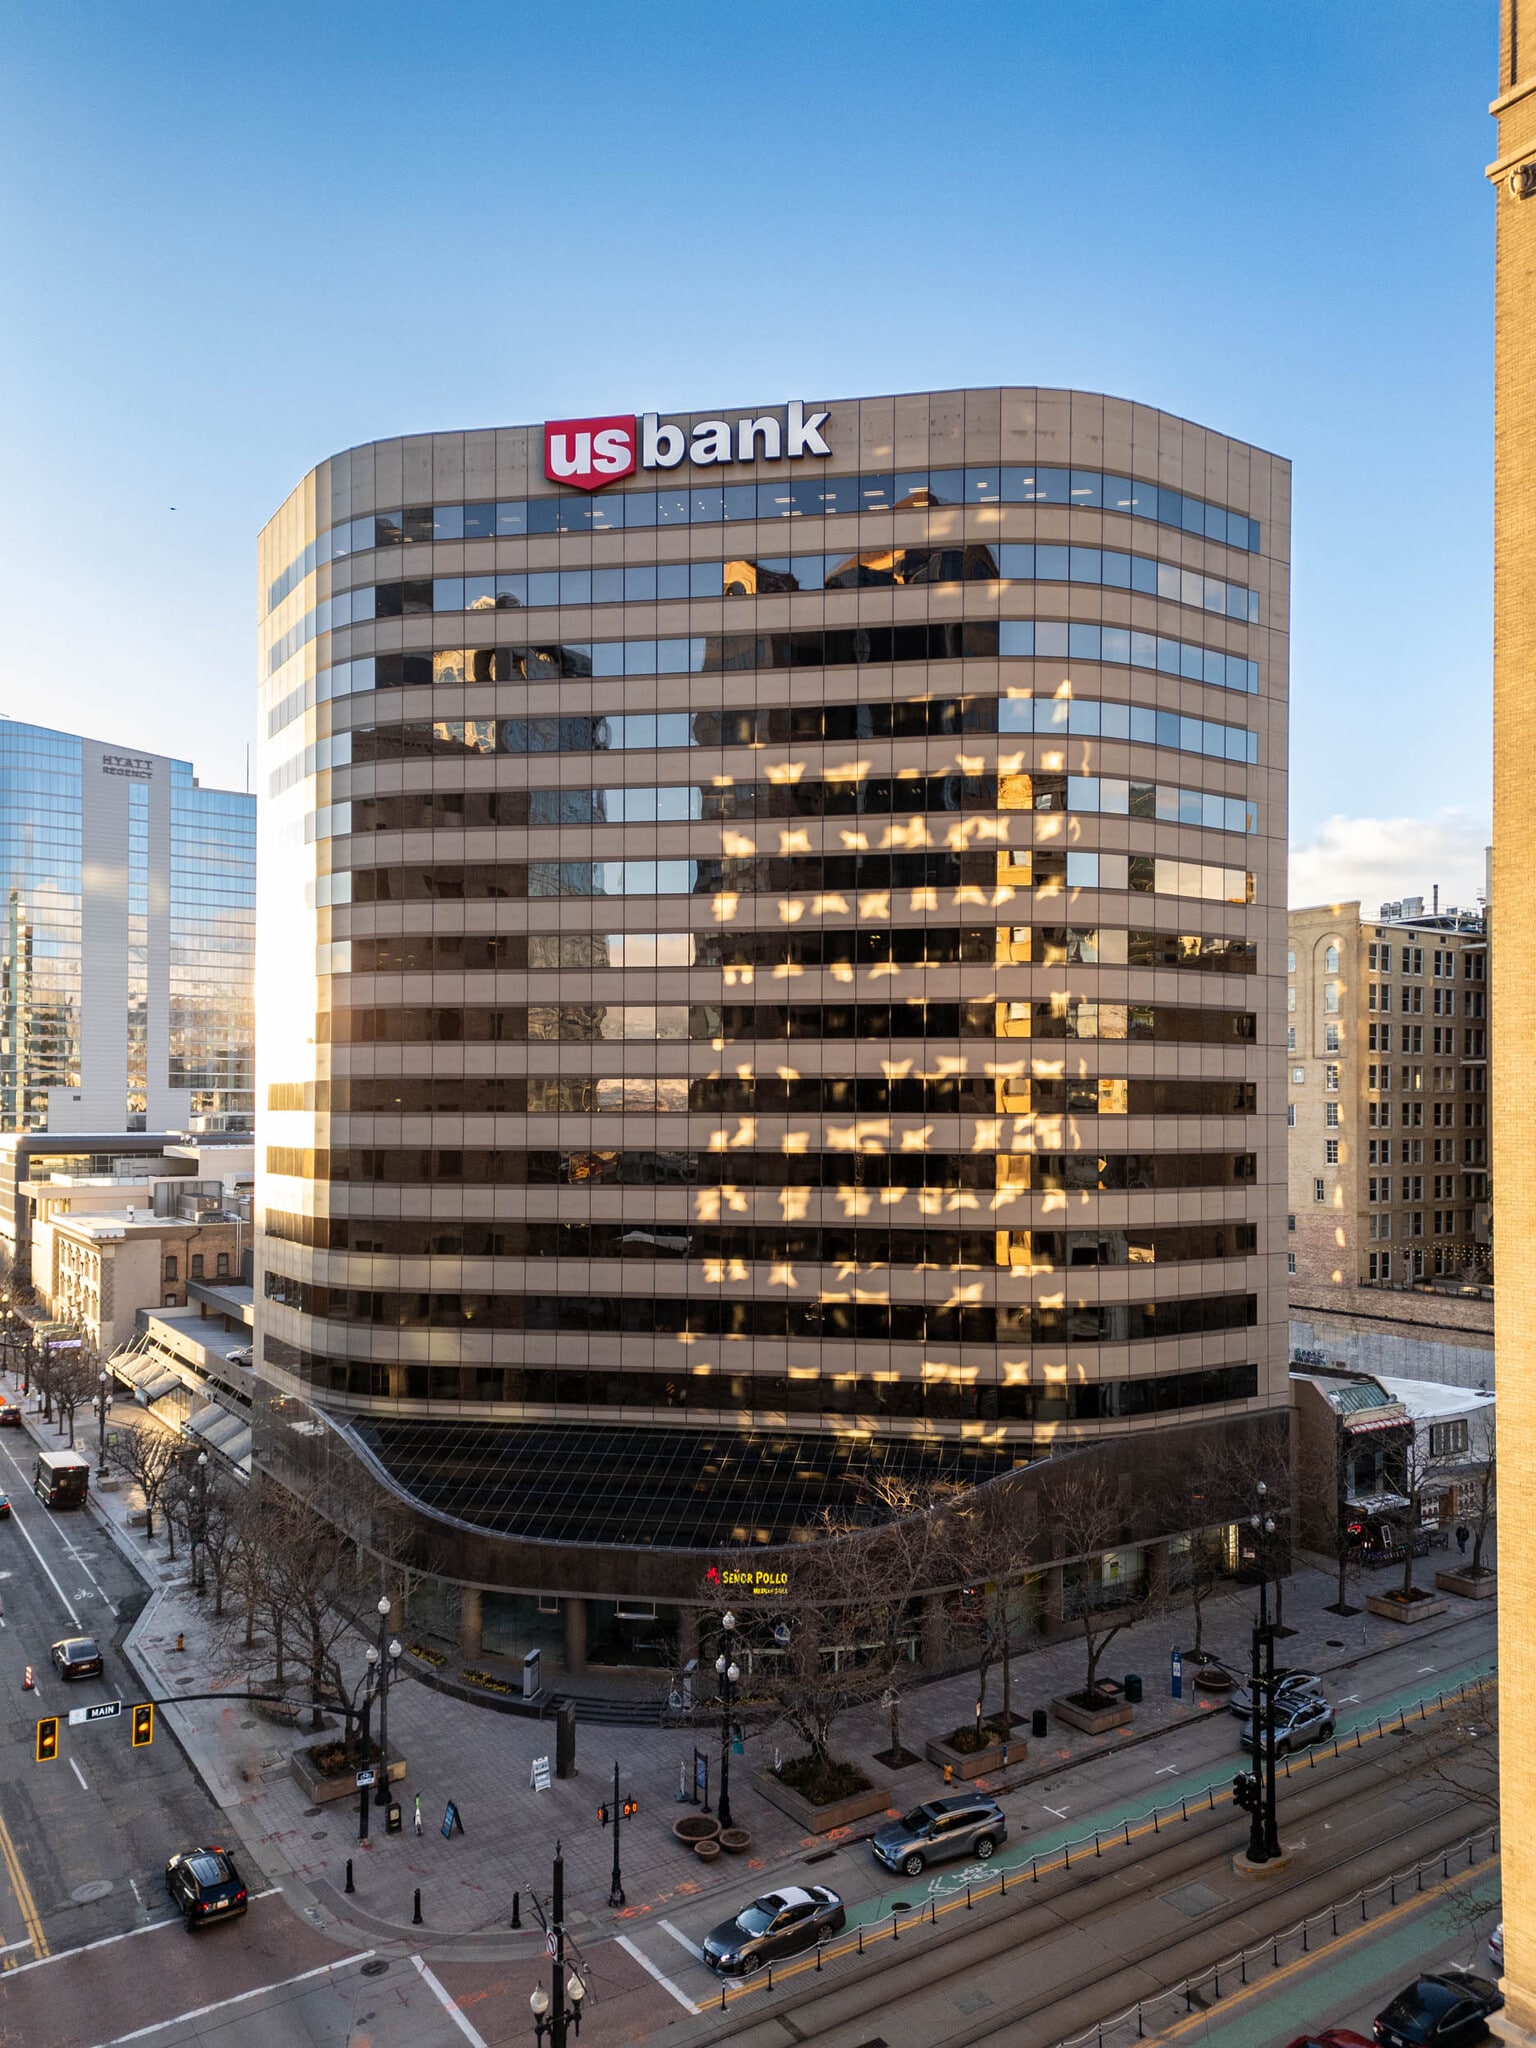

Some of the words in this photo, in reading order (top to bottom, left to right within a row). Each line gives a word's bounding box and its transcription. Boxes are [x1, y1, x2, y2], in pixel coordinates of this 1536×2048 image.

[550, 428, 632, 477] us
[642, 400, 831, 470] bank
[103, 754, 153, 770] HYATT
[102, 766, 153, 780] REGENCY
[91, 1705, 115, 1718] MAIN
